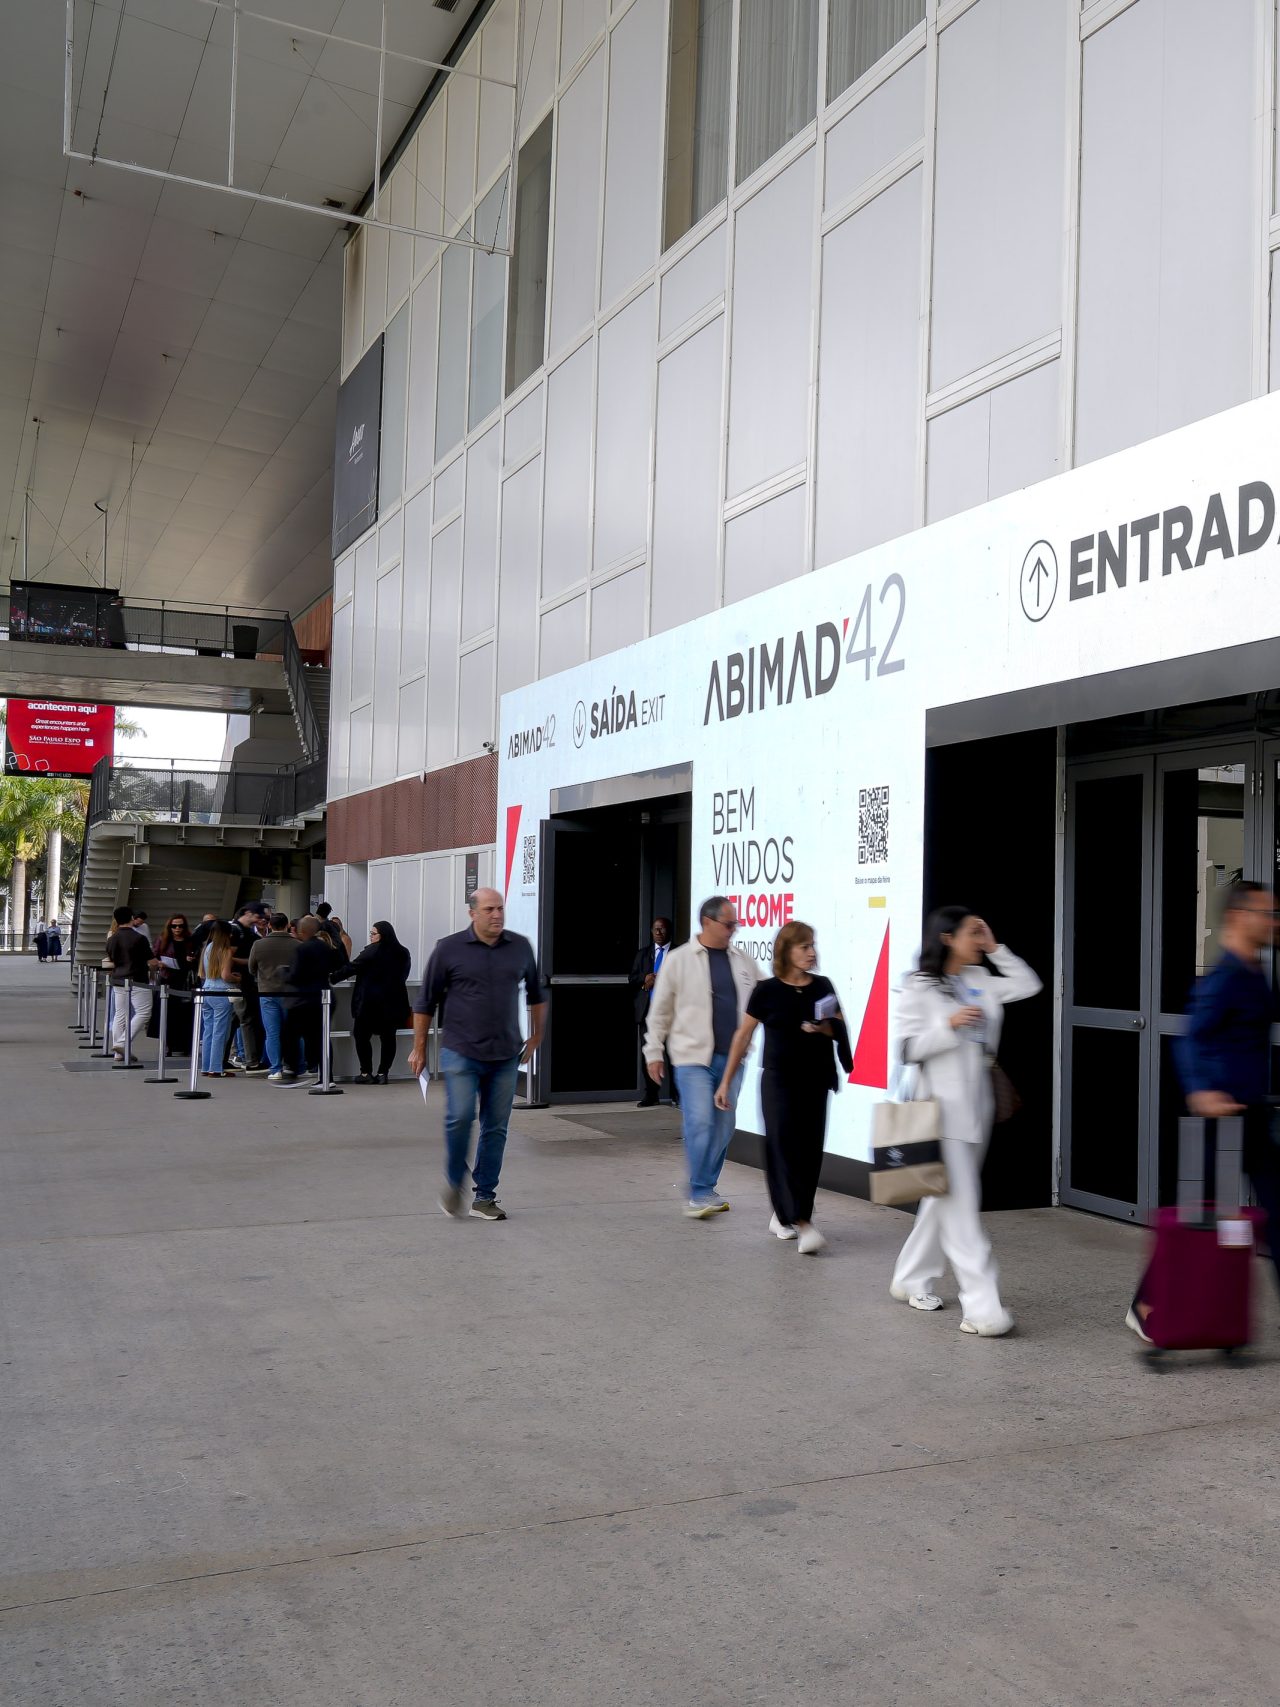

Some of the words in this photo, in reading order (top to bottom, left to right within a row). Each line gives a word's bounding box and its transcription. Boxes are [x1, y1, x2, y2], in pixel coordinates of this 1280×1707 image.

[27, 702, 76, 712] acontecem
[78, 705, 97, 714] aqui
[590, 685, 638, 739] SAÍDA
[641, 694, 666, 726] EXIT
[712, 786, 755, 835] BEM
[711, 836, 794, 886] VINDOS
